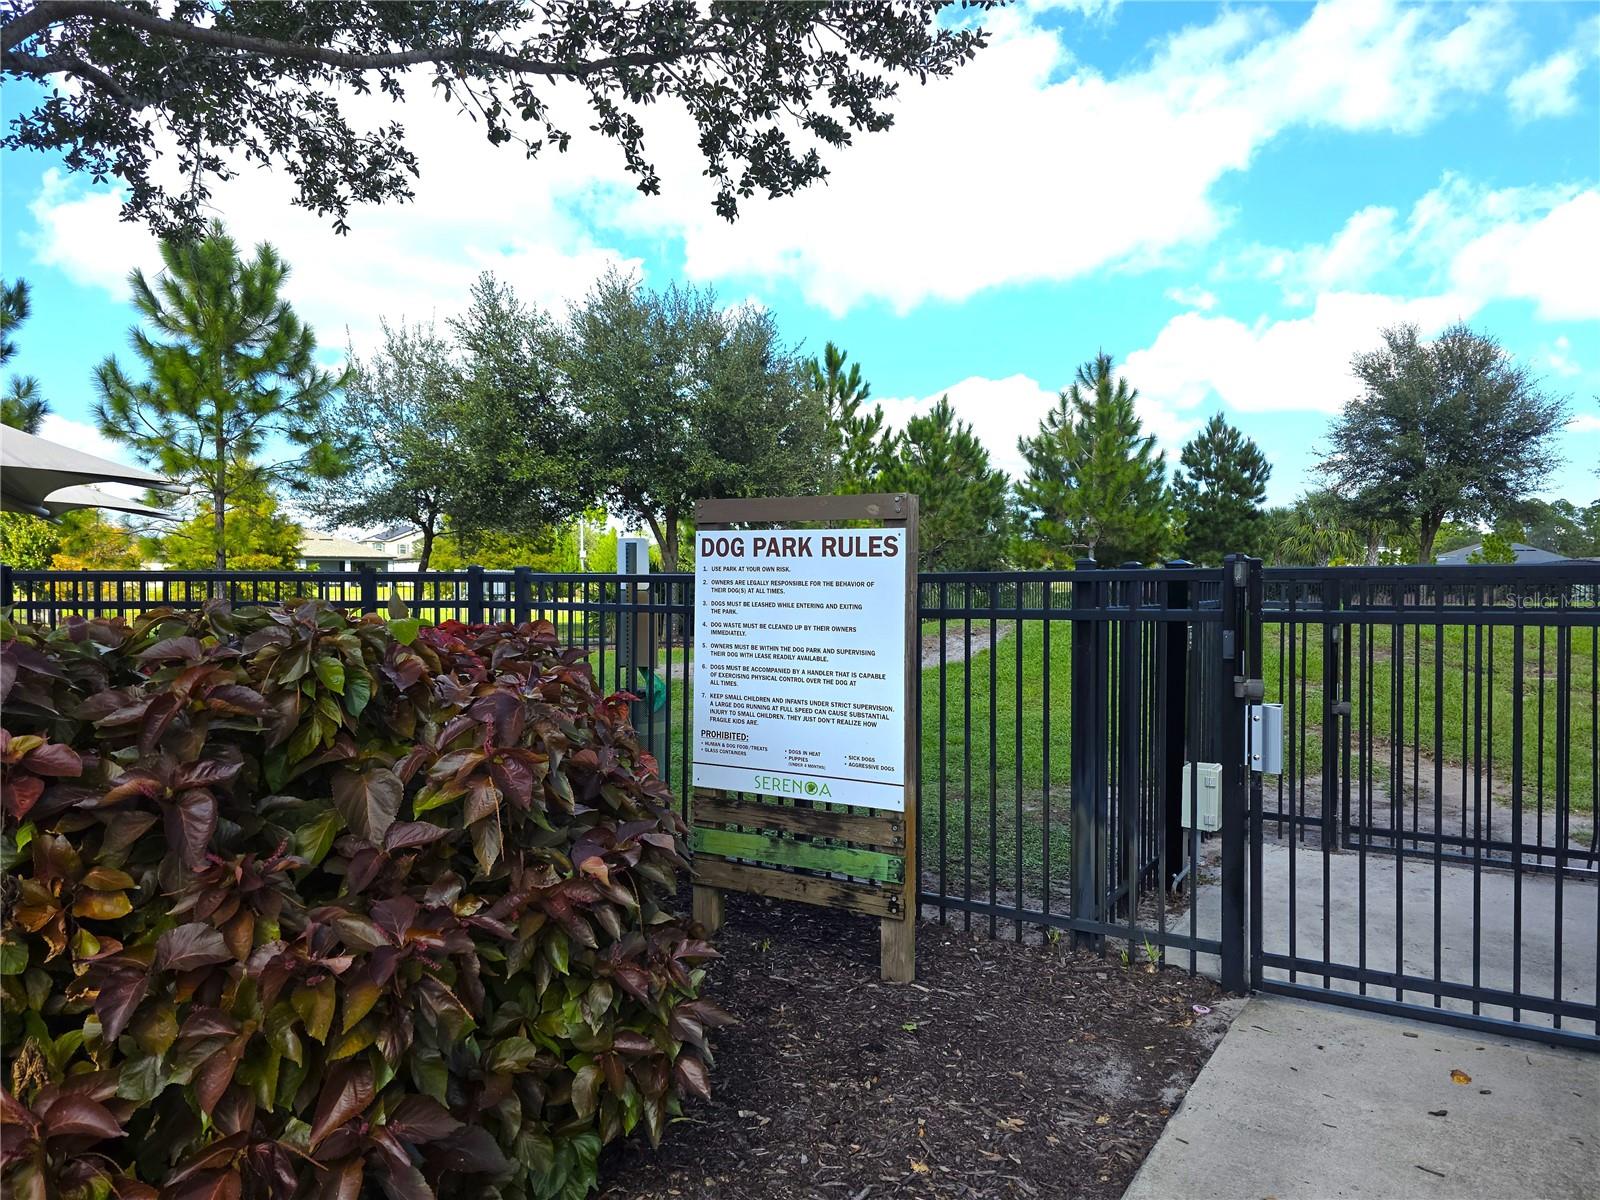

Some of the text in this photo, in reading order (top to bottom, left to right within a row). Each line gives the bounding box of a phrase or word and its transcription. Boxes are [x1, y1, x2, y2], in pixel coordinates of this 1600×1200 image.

[702, 536, 898, 558] DOG PARK RULES
[853, 703, 894, 712] SUPERVISION.
[757, 712, 786, 720] CHILDREN.
[836, 718, 861, 726] REALIZE
[849, 711, 889, 720] SUBSTANTIAL
[701, 730, 748, 742] PROHIBITED:
[848, 762, 879, 770] AGGRESSIVE
[755, 776, 832, 797] SERENOA
